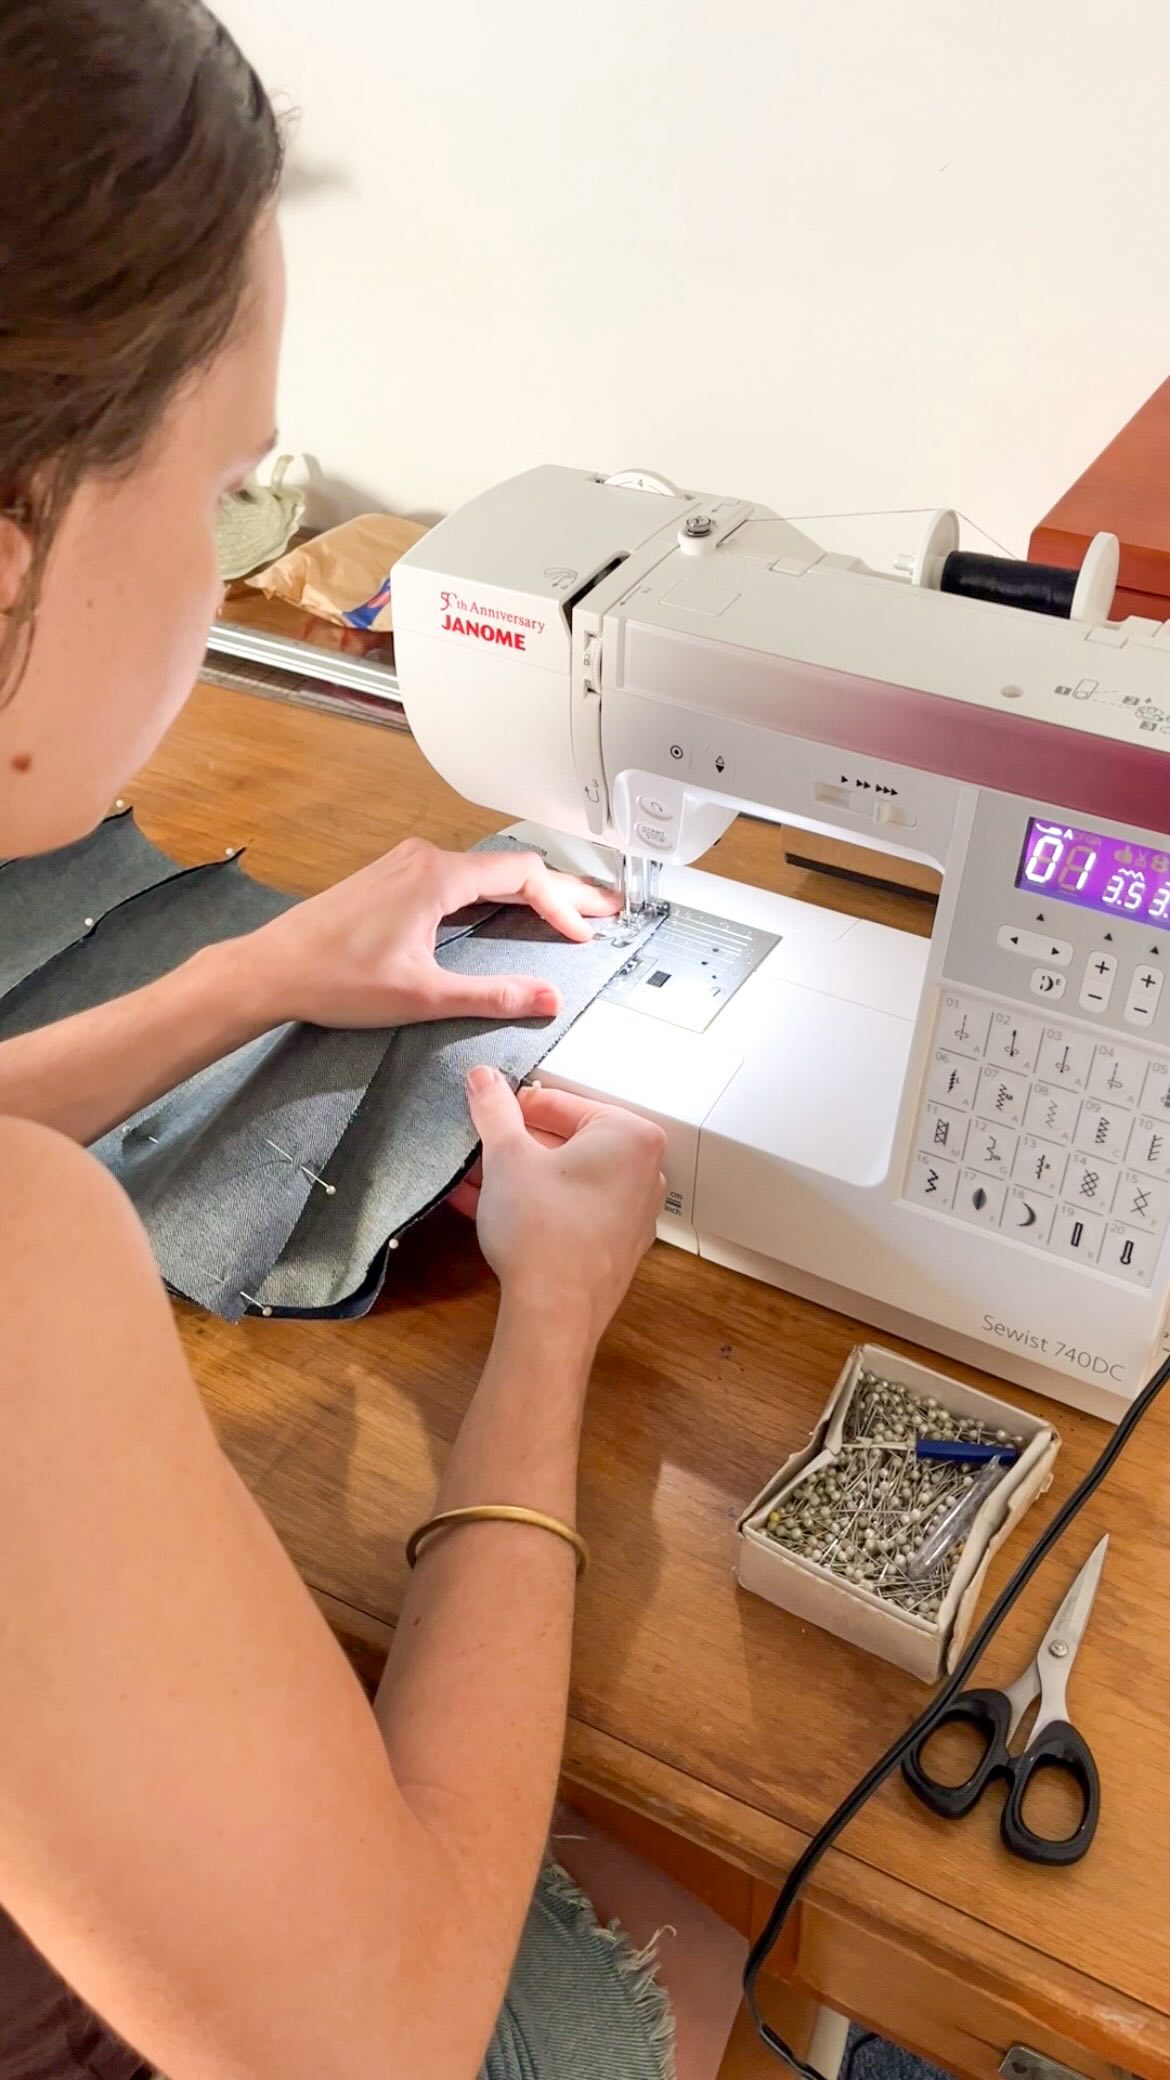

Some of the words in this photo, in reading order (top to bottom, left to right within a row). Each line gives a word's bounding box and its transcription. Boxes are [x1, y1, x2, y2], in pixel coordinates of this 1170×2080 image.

[470, 601, 545, 634] Anniversary
[441, 614, 526, 651] JANOME
[1102, 875, 1147, 910] 3.5
[946, 997, 959, 1008] 01
[996, 1013, 1010, 1025] 02
[1046, 1029, 1061, 1041] 03
[1099, 1046, 1114, 1057] 04
[984, 1067, 999, 1078] 07
[1152, 1062, 1168, 1075] 05
[1034, 1083, 1049, 1096] 08
[975, 1120, 988, 1131] 12
[1140, 1118, 1153, 1130] 10
[1024, 1136, 1037, 1148] 13
[1126, 1172, 1138, 1183] 15
[670, 1191, 683, 1201] cm
[1062, 1205, 1074, 1216] 19
[1110, 1223, 1125, 1235] 20
[982, 1314, 1048, 1352] Sewist
[1054, 1341, 1126, 1382] 740DC
